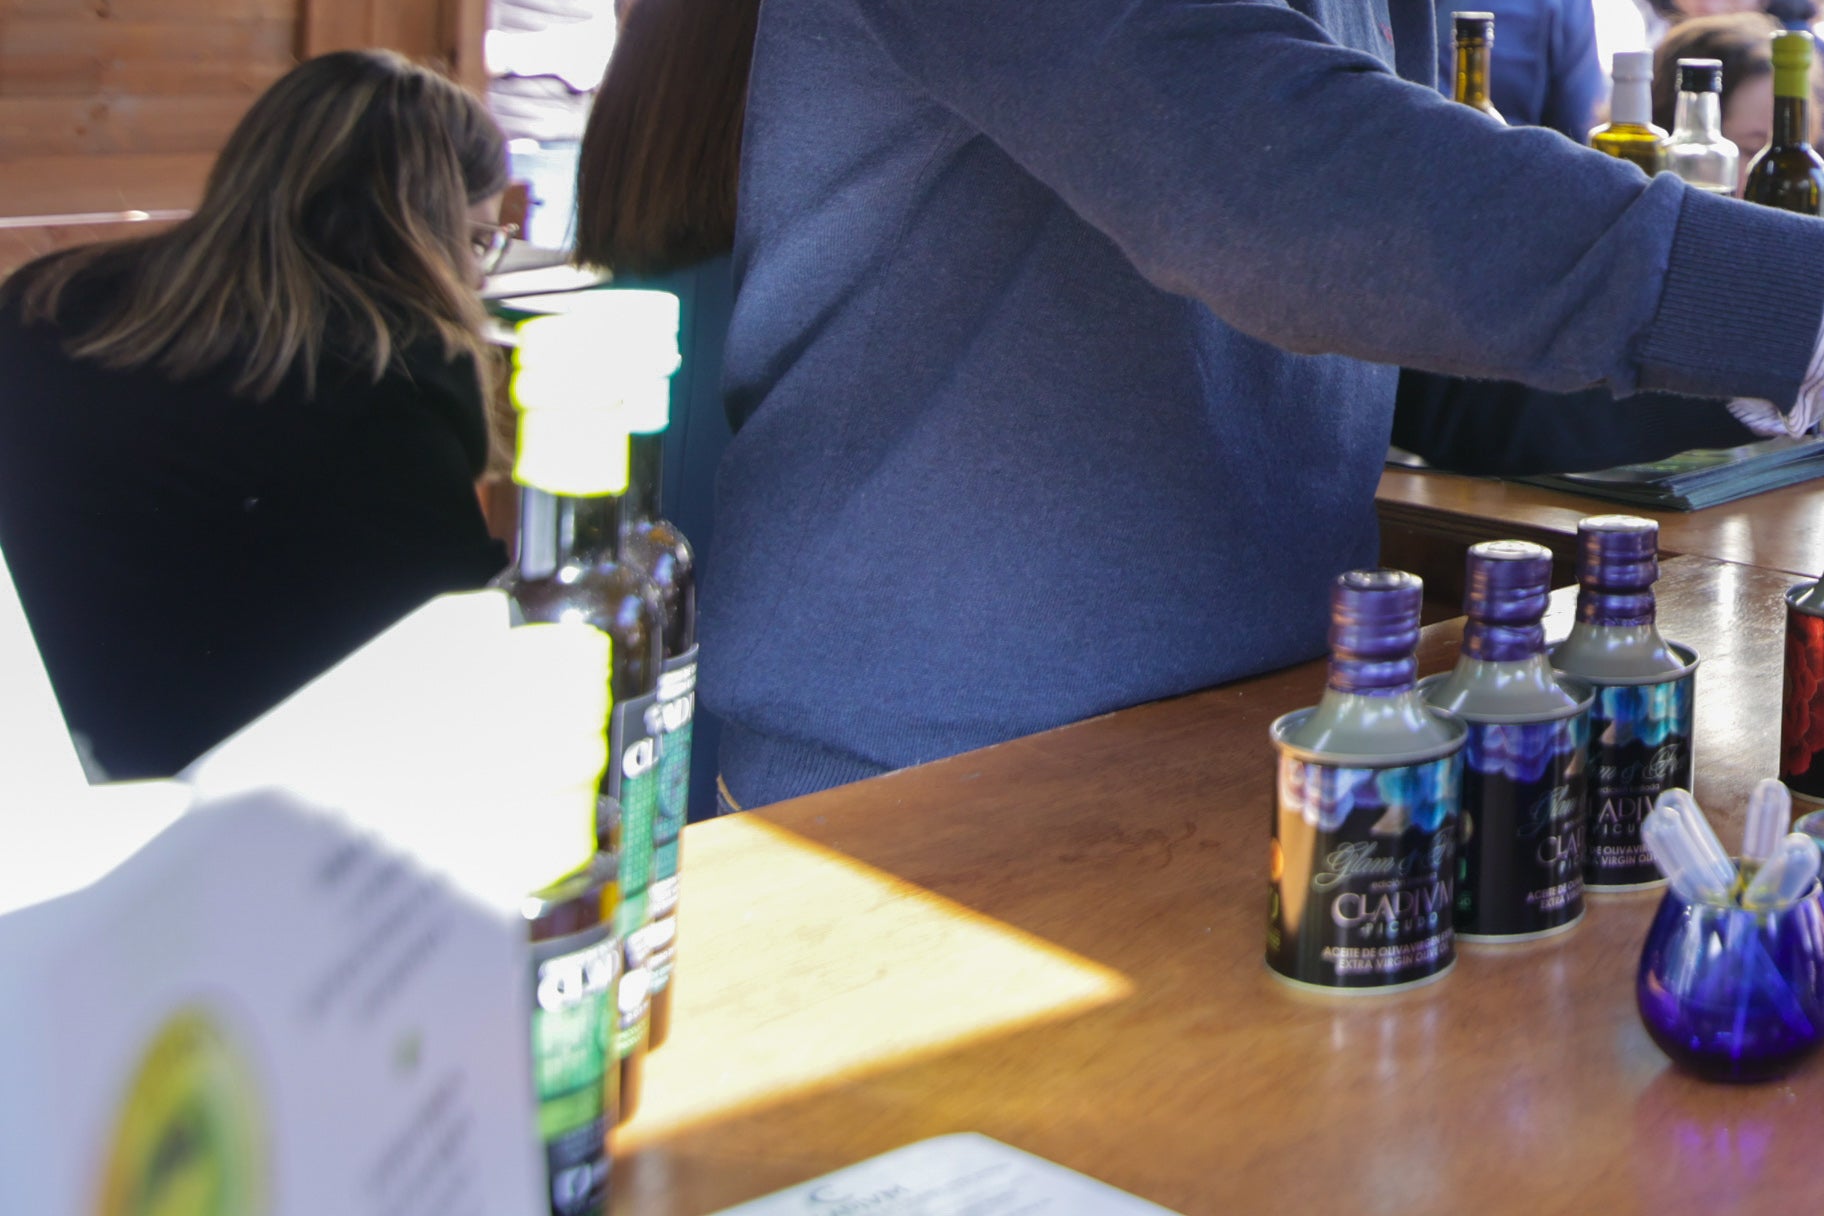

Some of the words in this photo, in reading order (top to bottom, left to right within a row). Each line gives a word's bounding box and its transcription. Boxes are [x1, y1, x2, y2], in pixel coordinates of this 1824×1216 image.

[1603, 845, 1633, 855] OLIVA
[1601, 855, 1636, 865] VIRGIN
[1363, 910, 1439, 934] PICUDO
[1324, 945, 1360, 959] ACEITE
[1361, 945, 1377, 958] DE
[1378, 941, 1410, 957] OLIVA
[1338, 957, 1374, 971] EXTRA
[1376, 954, 1413, 969] VIRGIN
